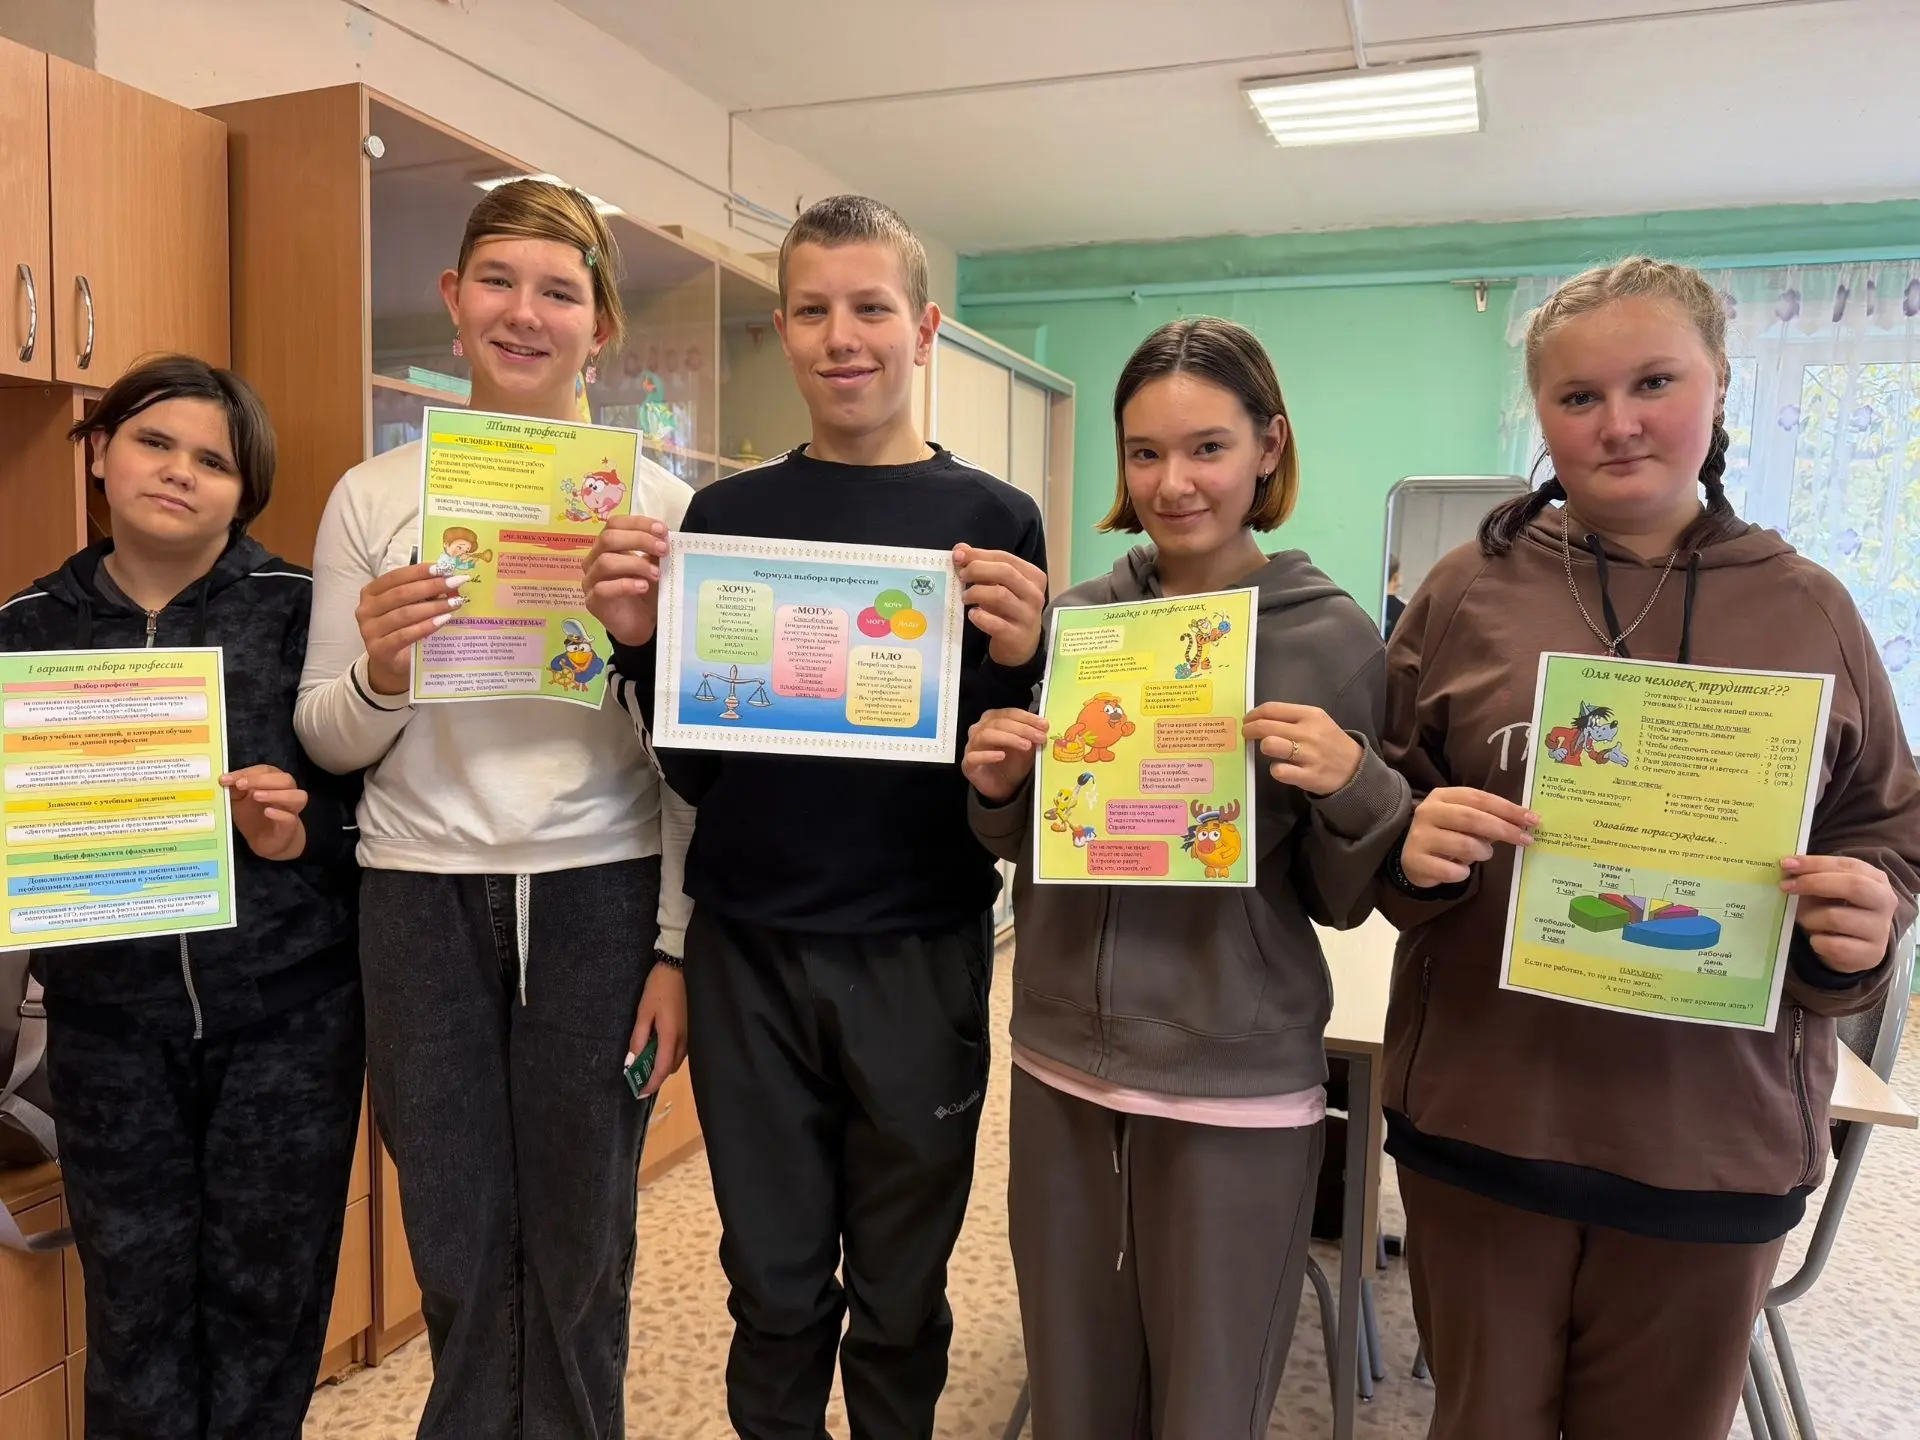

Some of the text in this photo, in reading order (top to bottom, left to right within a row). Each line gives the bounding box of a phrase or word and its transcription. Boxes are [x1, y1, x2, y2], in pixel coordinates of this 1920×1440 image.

[871, 652, 902, 661] НАДО
[1582, 668, 1610, 679] Для
[1614, 673, 1641, 683] чего
